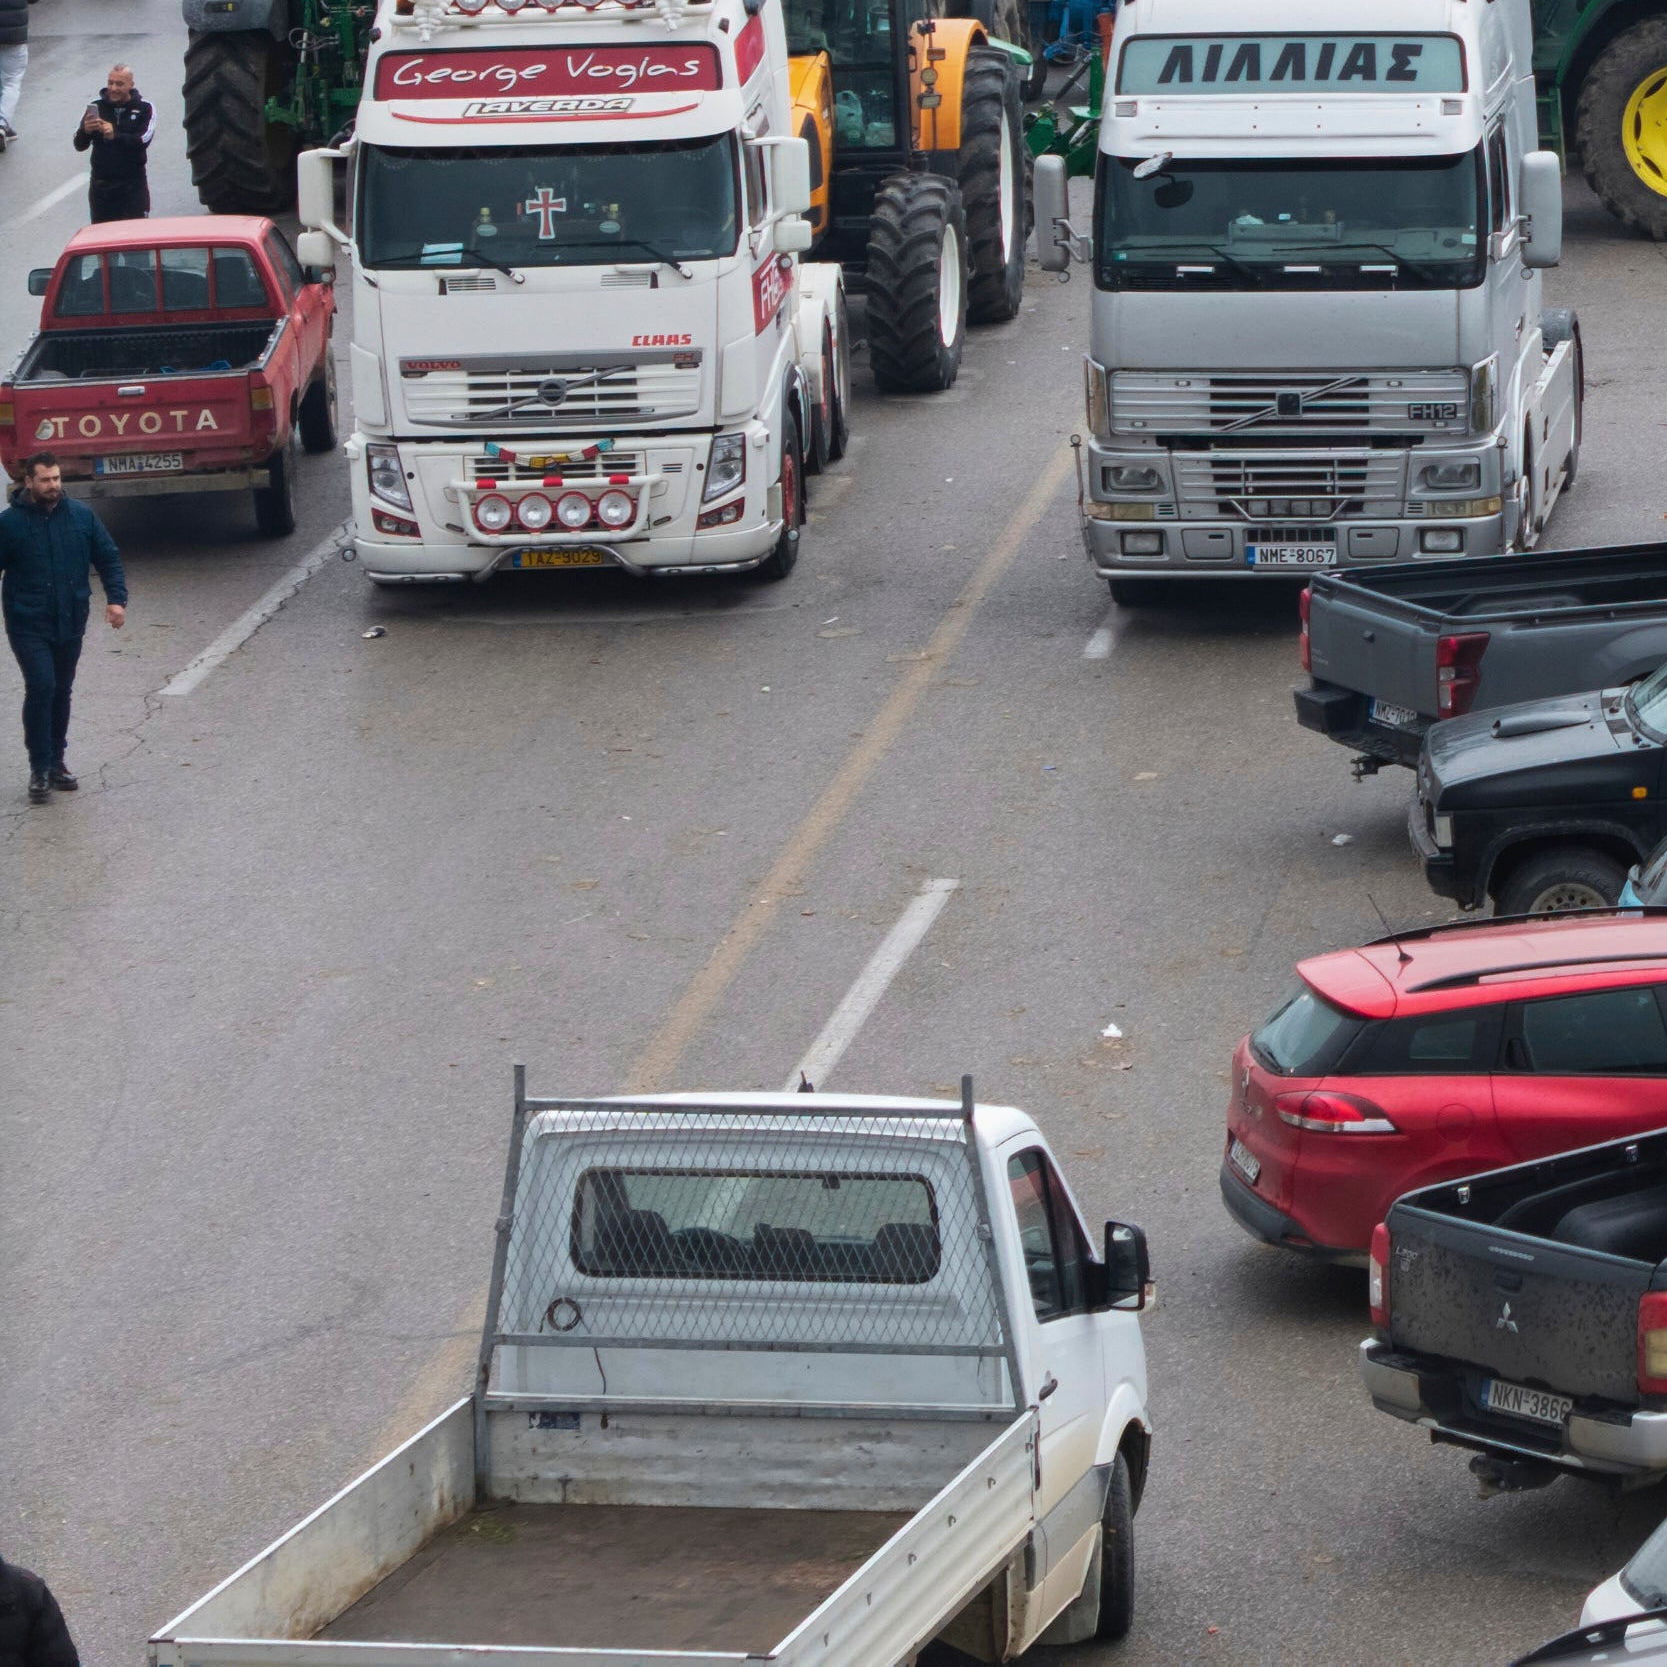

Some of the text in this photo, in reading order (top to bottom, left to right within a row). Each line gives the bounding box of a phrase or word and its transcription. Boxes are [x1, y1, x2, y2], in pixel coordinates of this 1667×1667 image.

[1157, 43, 1423, 83] ΛΙΛΛΙΑΣ
[393, 58, 547, 91] George
[464, 98, 636, 116] LAVERDA
[631, 334, 693, 346] CLAAS
[407, 361, 461, 370] VOLVO
[1409, 404, 1457, 418] FH12
[50, 409, 218, 438] TOYOTA
[1260, 548, 1335, 562] NME-8067
